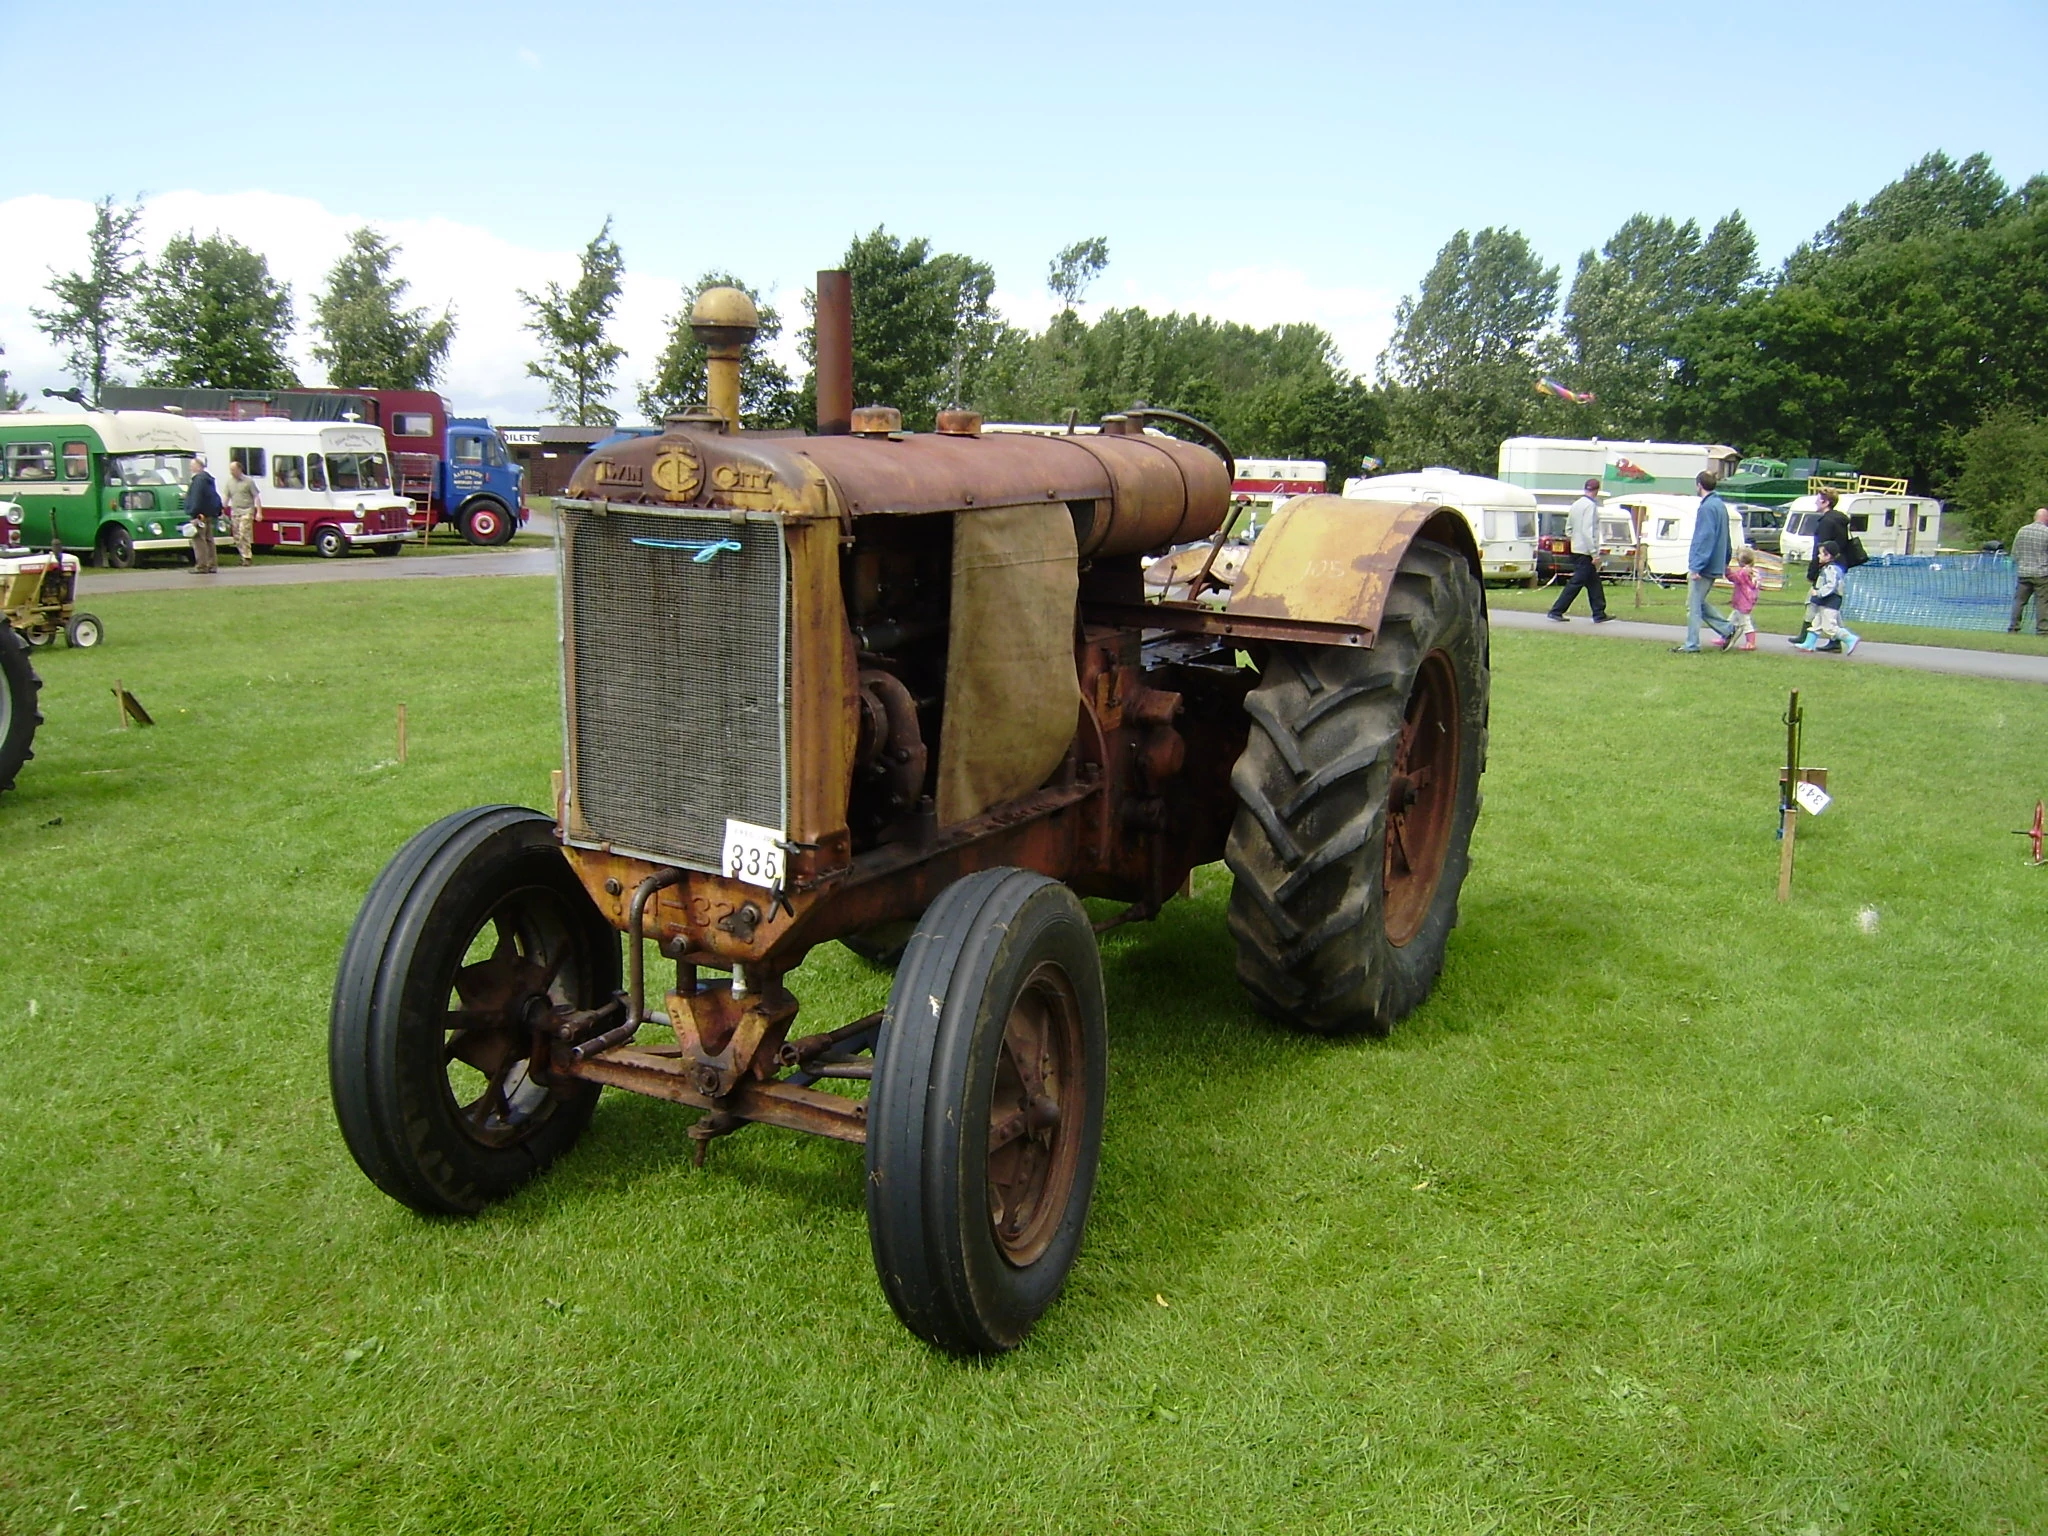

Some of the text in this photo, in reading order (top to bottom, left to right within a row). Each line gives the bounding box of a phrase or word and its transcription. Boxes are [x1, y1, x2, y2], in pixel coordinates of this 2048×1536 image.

[594, 458, 643, 482] TWIN
[712, 464, 774, 489] CITY
[731, 844, 776, 880] 335
